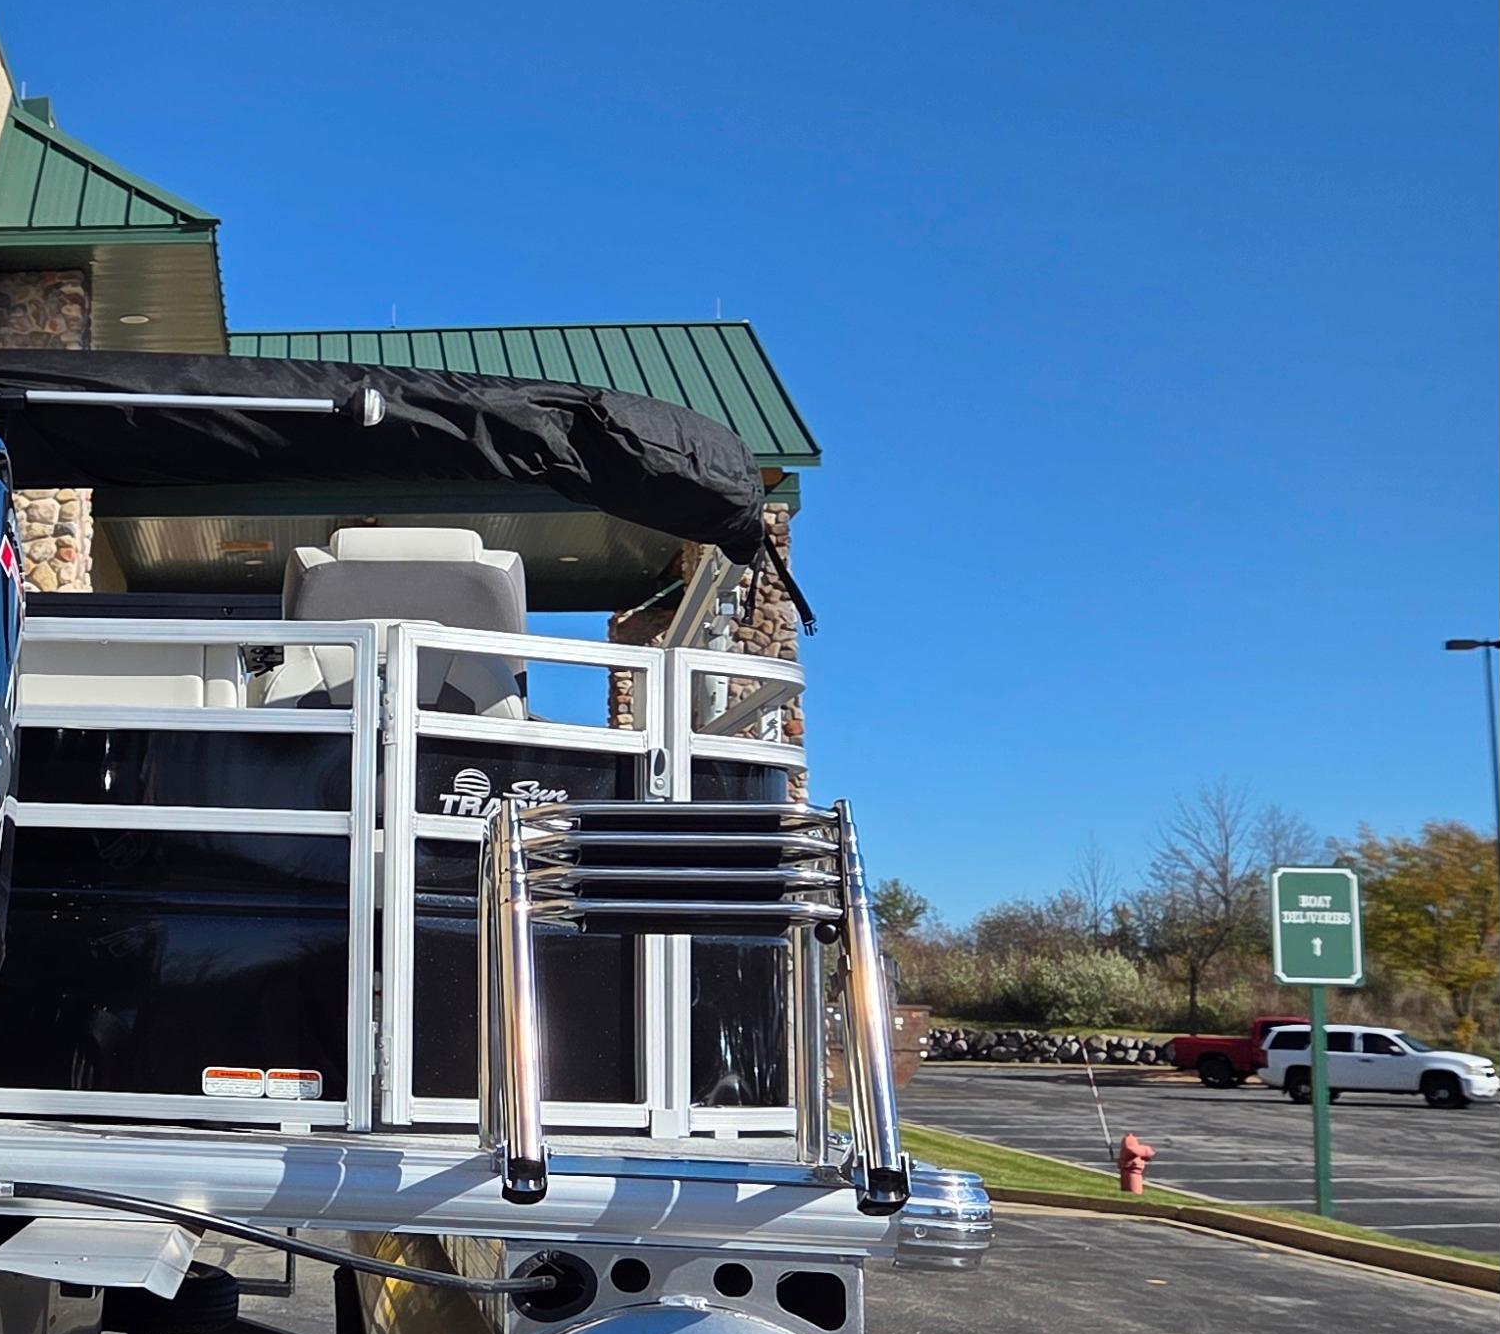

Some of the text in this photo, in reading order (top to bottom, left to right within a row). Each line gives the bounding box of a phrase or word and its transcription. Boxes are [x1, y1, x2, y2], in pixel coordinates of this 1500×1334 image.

[502, 780, 569, 803] Sun
[1297, 894, 1333, 908] BOAT
[1281, 911, 1352, 925] DELIVERIES
